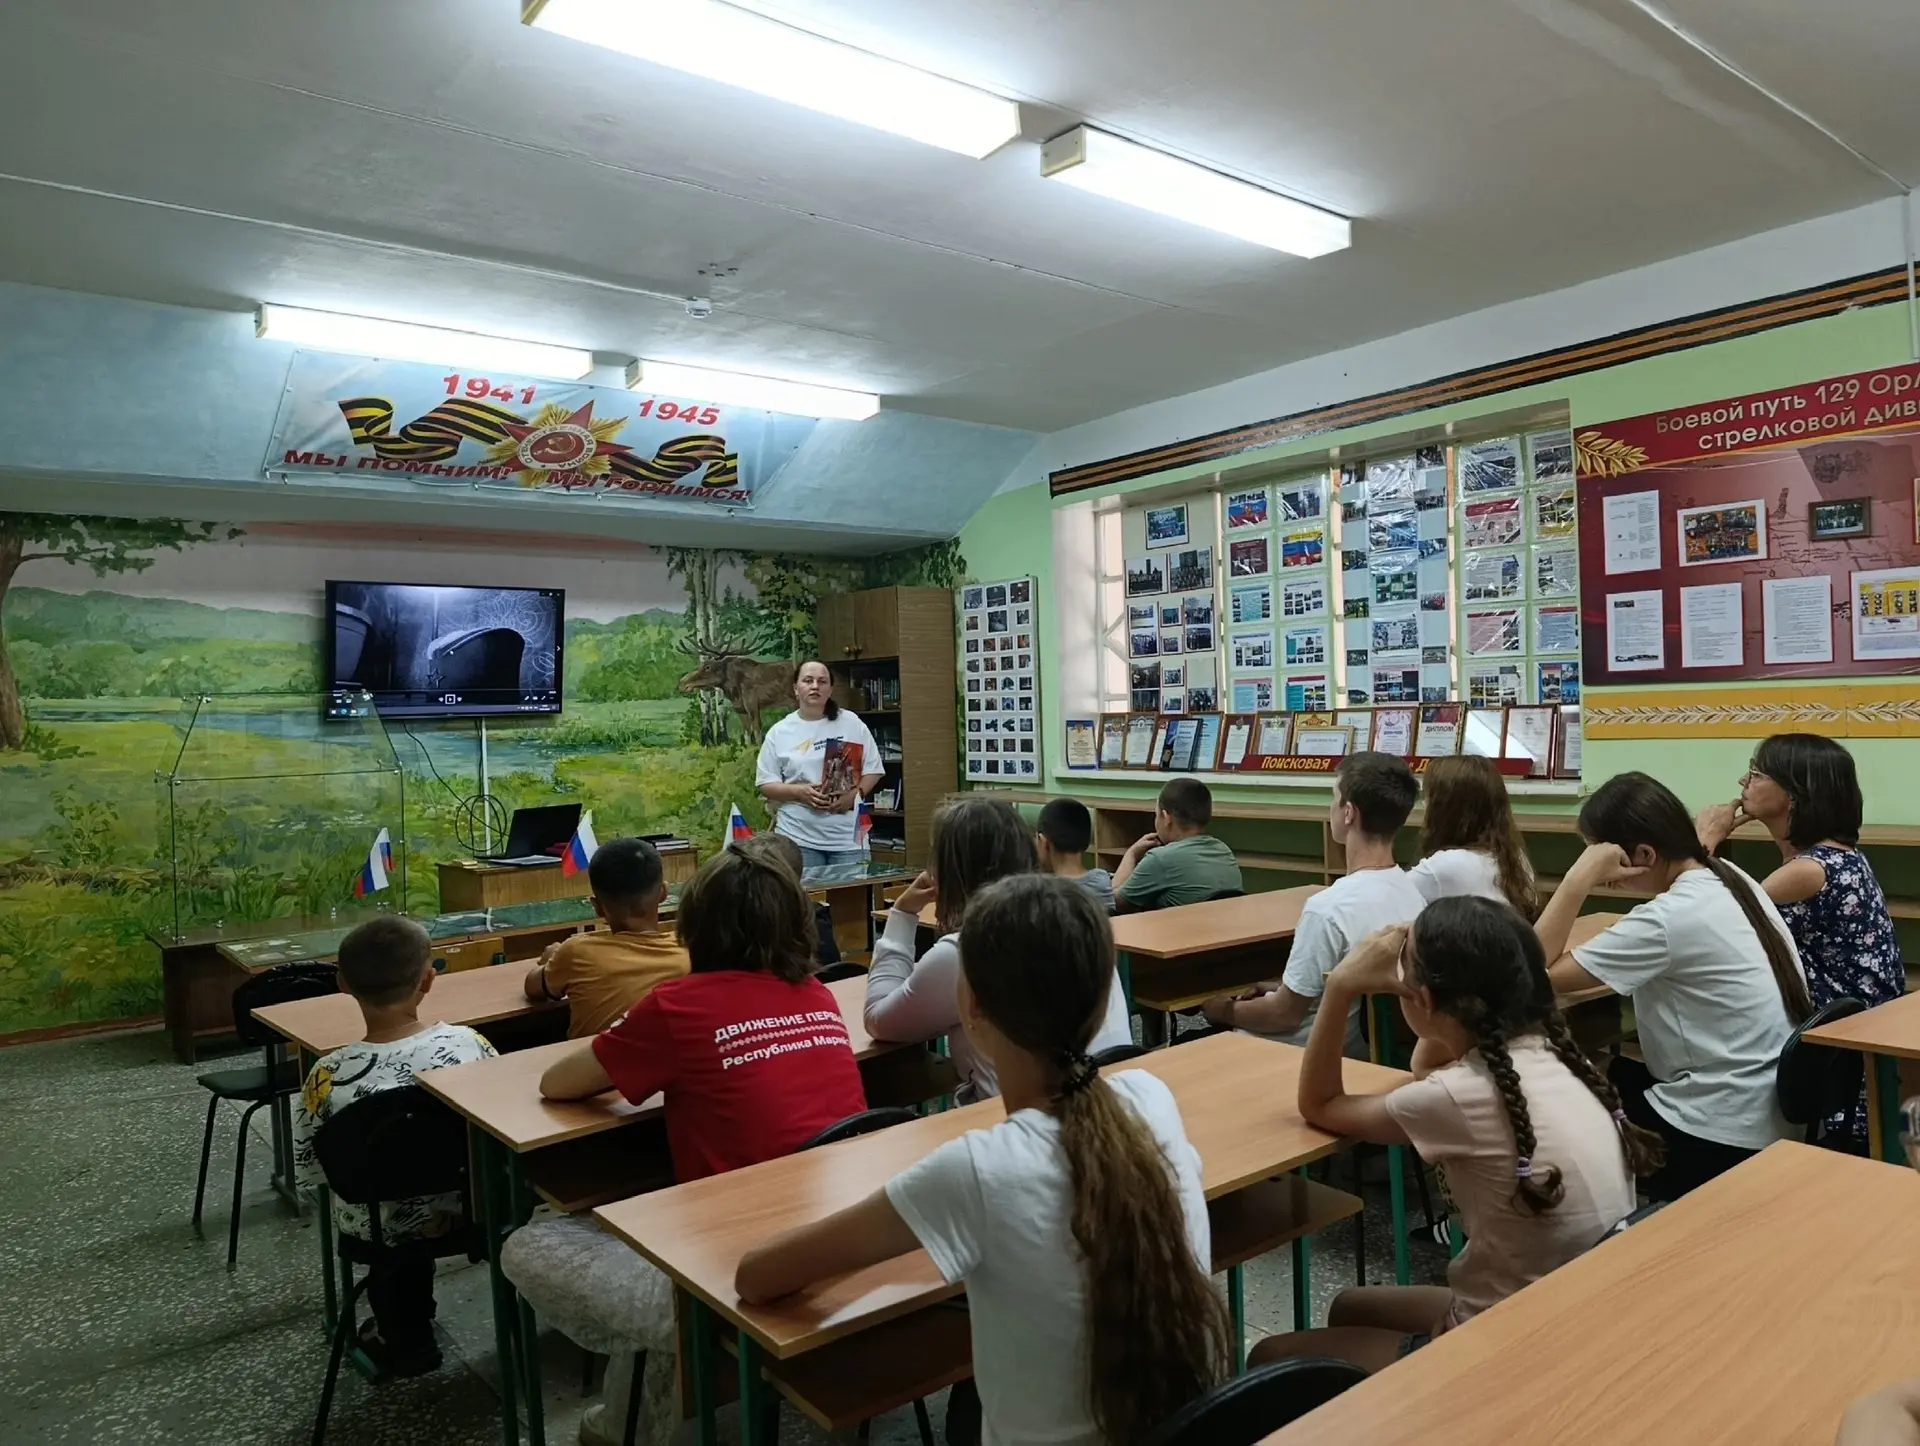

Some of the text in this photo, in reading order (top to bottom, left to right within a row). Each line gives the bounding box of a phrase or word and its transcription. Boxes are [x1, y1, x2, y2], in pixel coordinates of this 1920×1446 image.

[443, 374, 537, 404] 1941
[639, 399, 720, 425] 1945
[1656, 402, 1743, 434] Боевой
[1751, 393, 1806, 418] путь
[1815, 382, 1860, 404] 129
[1699, 400, 1920, 450] стрелковой див
[284, 450, 513, 480] МЫ ПОМНИМ!
[546, 470, 752, 501] МЫ ГОРДИМСЯ!
[714, 1013, 806, 1043] ДВИЖЕНИЕ
[722, 1039, 812, 1069] Республика
